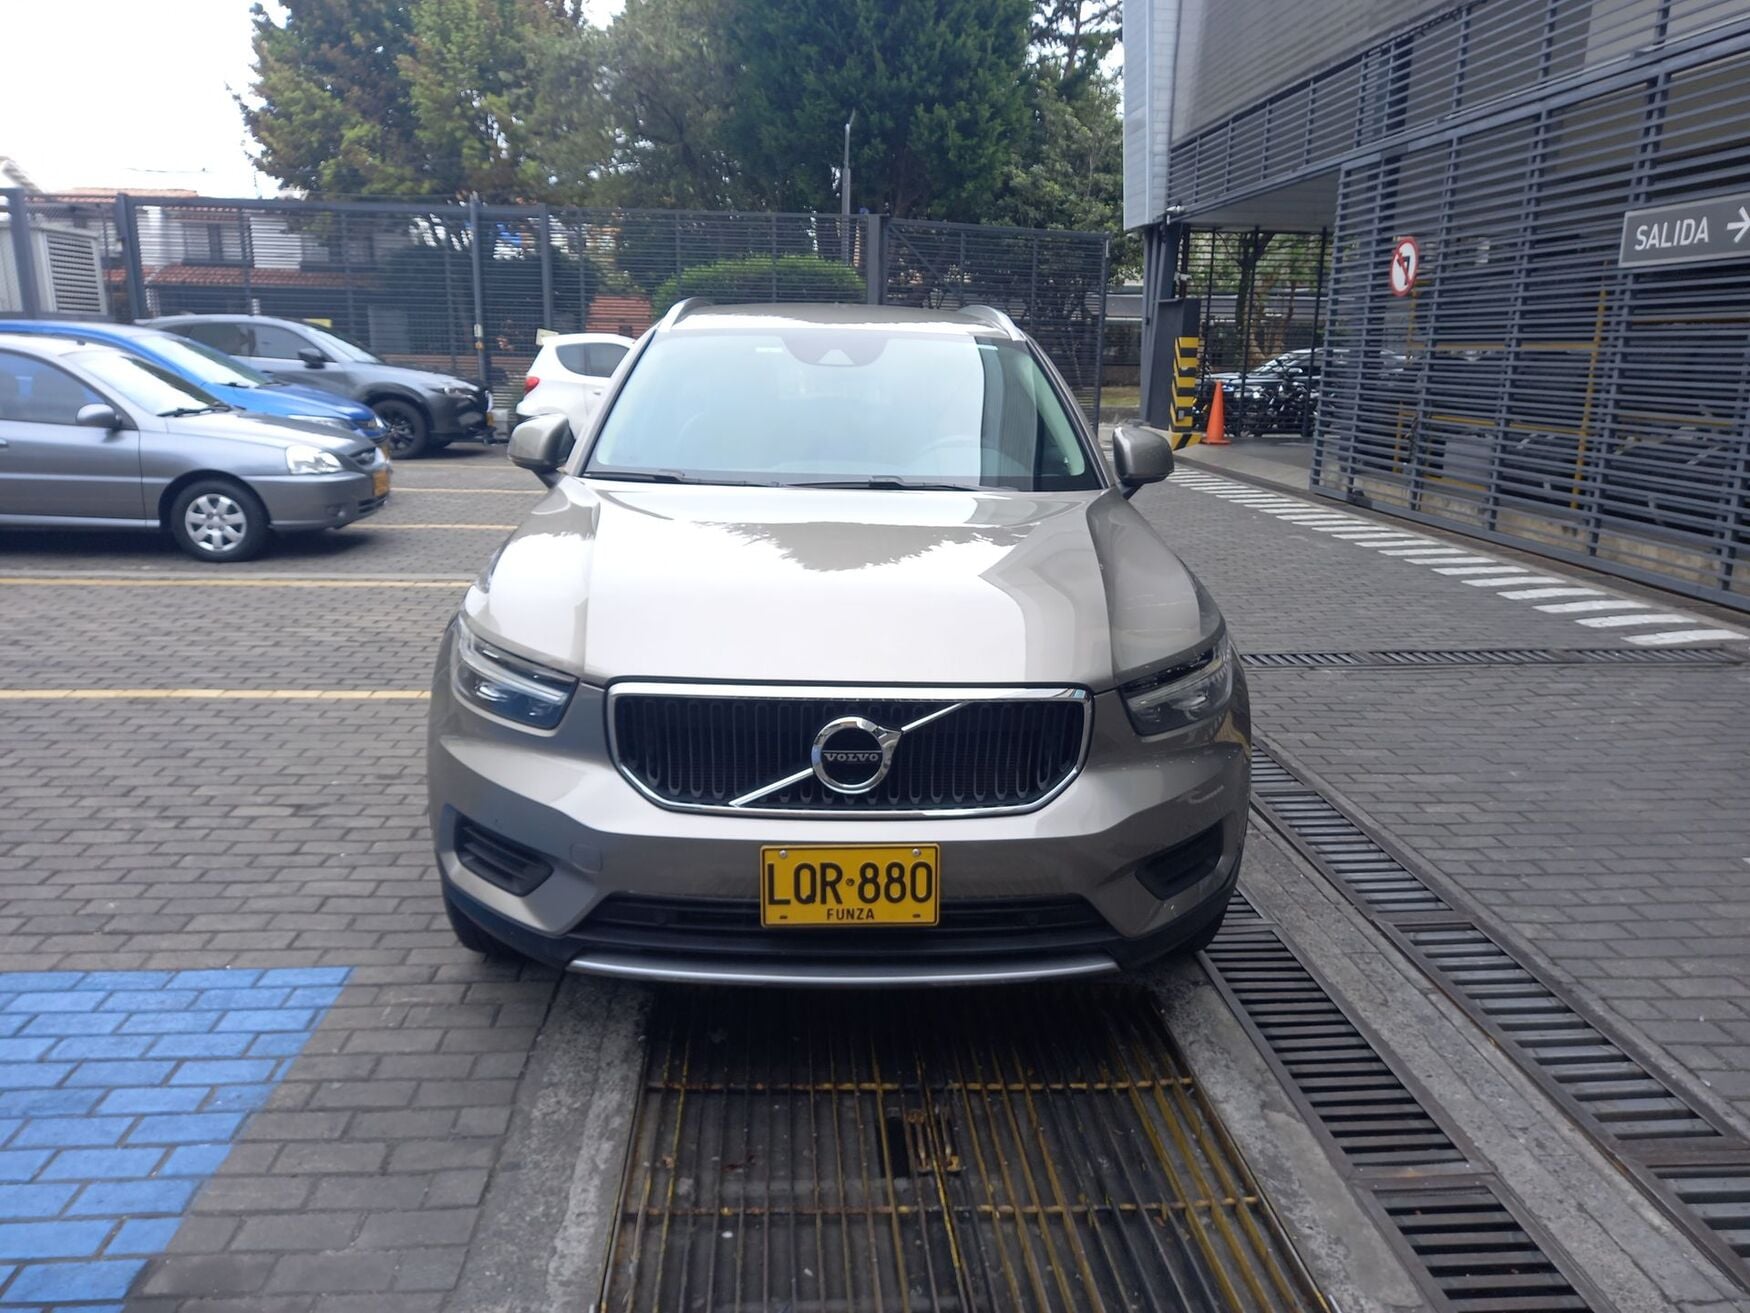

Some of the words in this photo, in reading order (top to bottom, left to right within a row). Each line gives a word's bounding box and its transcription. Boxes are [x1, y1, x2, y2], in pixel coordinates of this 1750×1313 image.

[1634, 216, 1709, 251] SALIDA
[823, 753, 879, 762] VOLVO
[857, 861, 933, 904] 880
[826, 908, 875, 921] FUNZA
